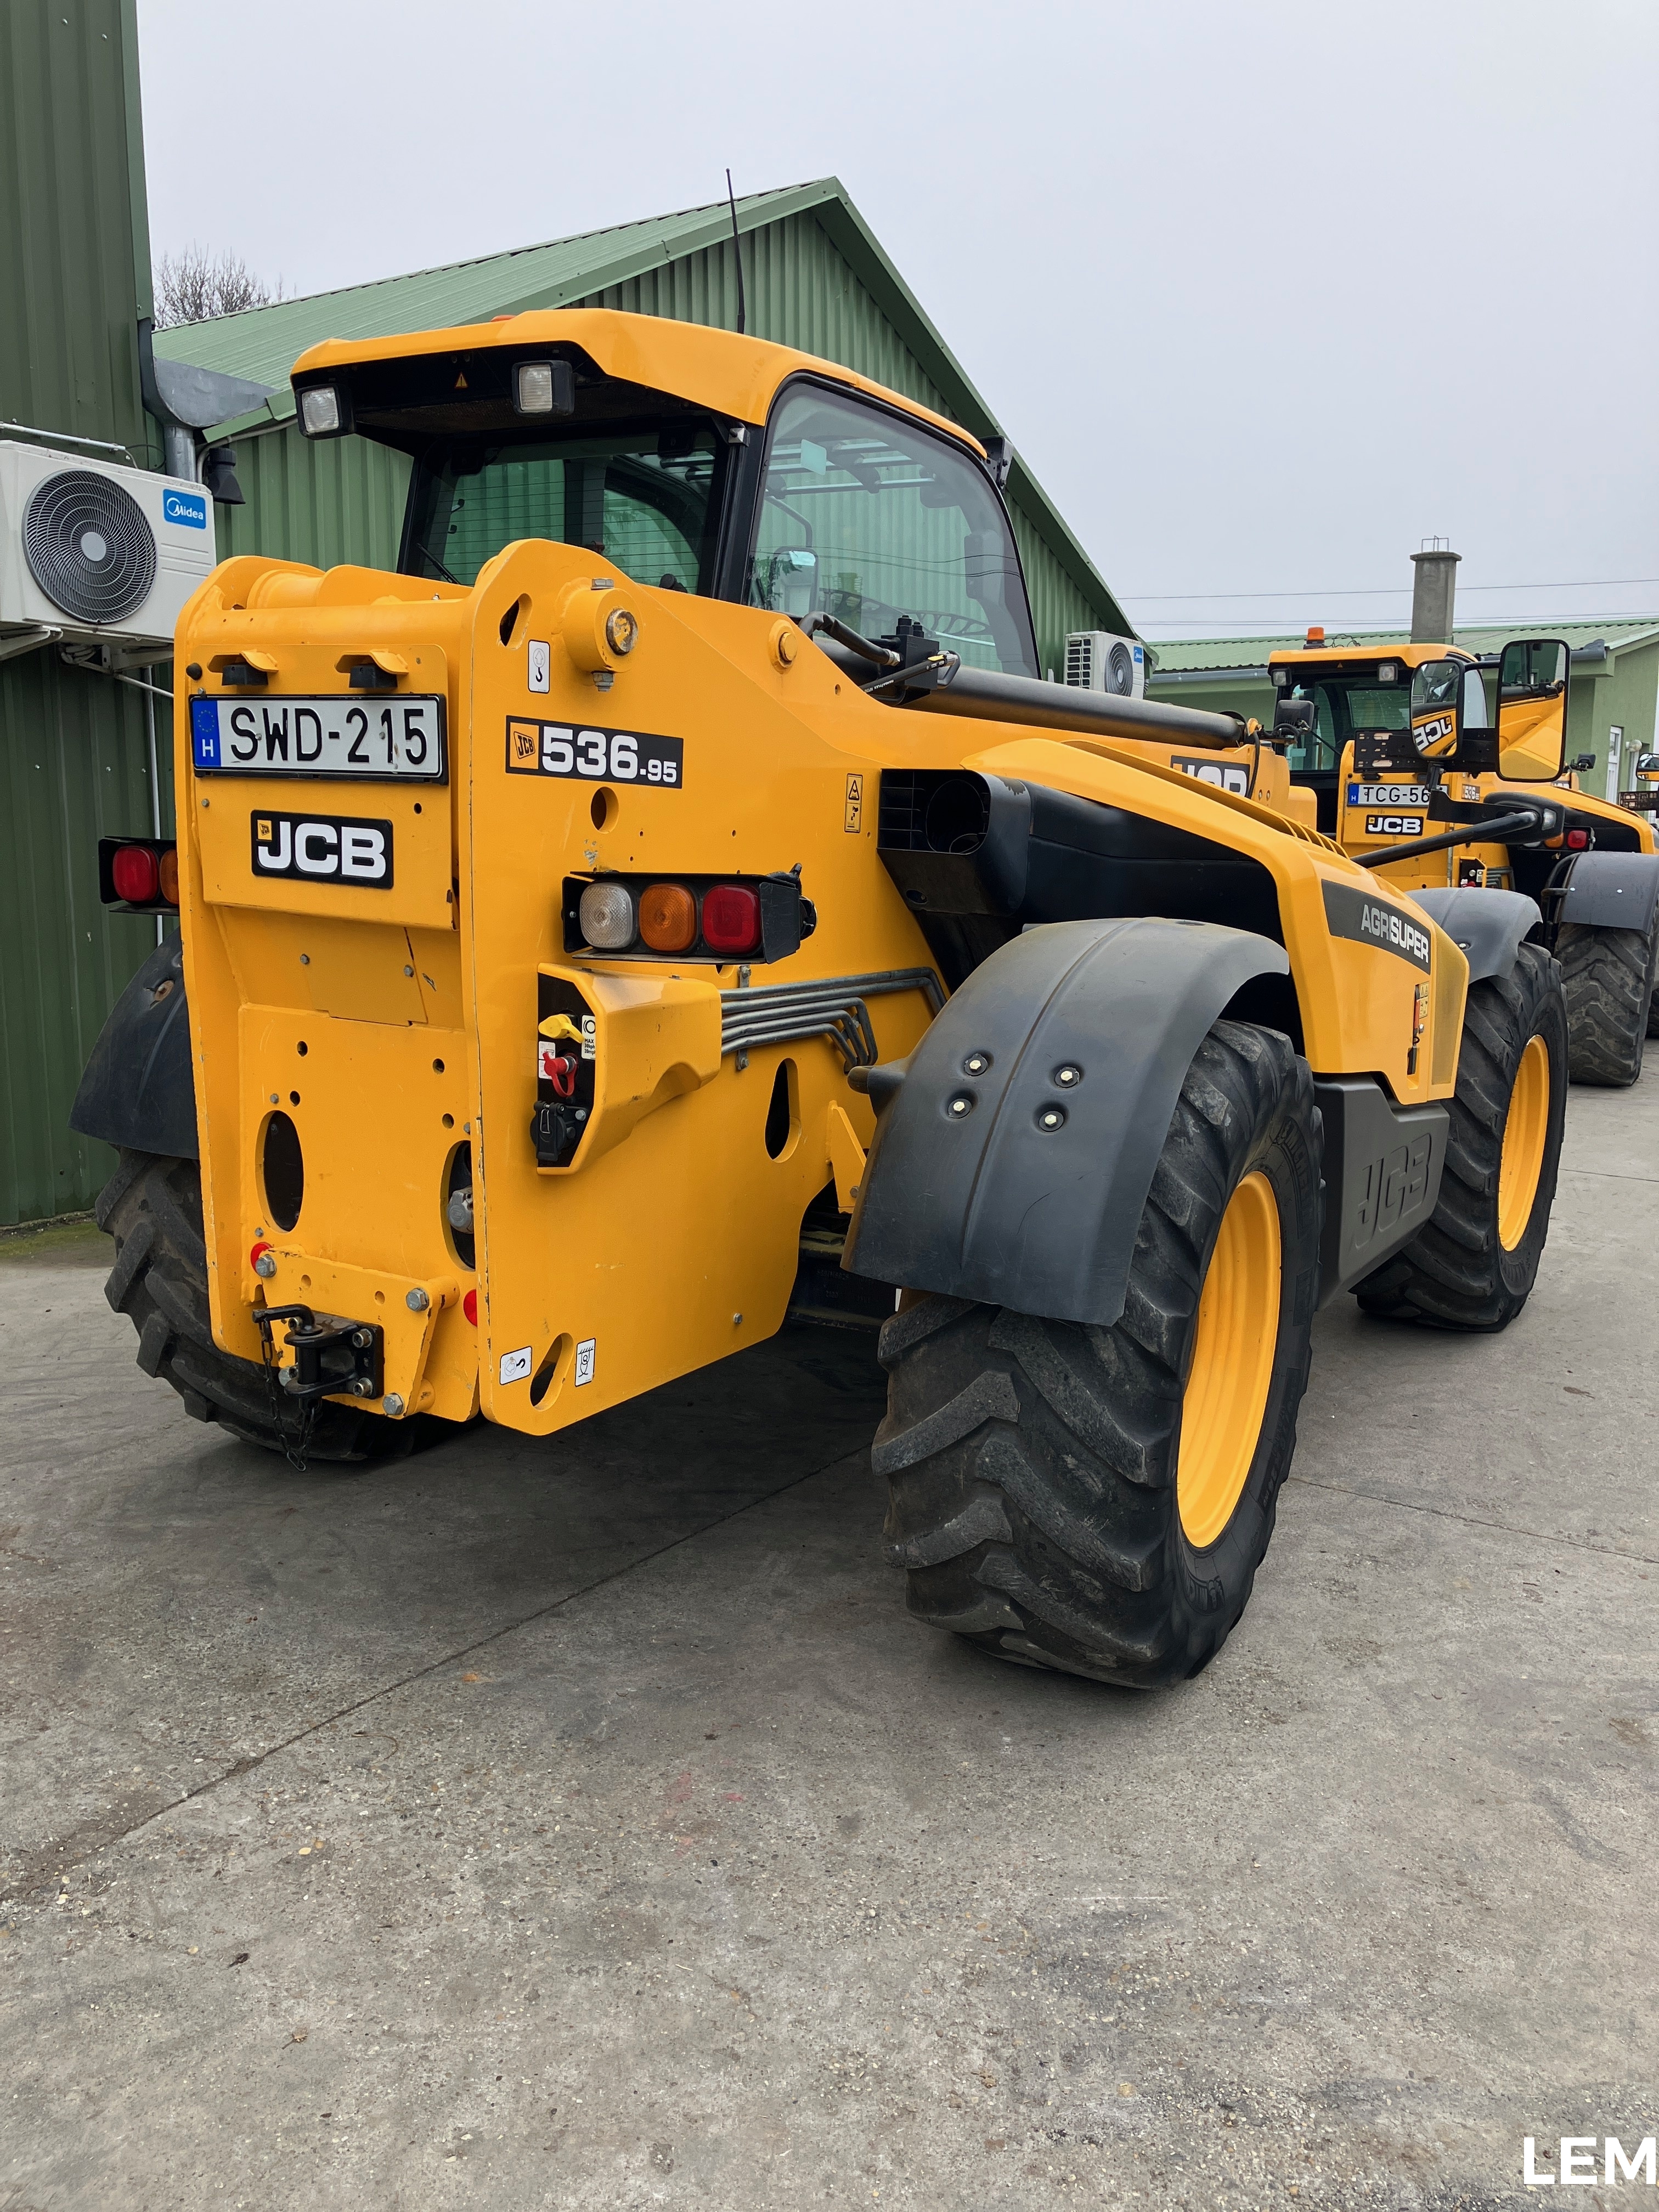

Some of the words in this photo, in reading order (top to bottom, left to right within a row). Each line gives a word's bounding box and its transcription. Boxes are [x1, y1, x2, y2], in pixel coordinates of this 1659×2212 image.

[167, 497, 204, 520] Midea
[202, 739, 214, 757] H
[230, 707, 427, 765] SWD-215
[516, 735, 534, 757] JCB
[1363, 787, 1442, 803] TCG-56
[1368, 817, 1420, 833] JCB
[258, 821, 386, 878] JCB
[1361, 904, 1429, 963] AGRISUPER
[1353, 1132, 1432, 1250] JCB
